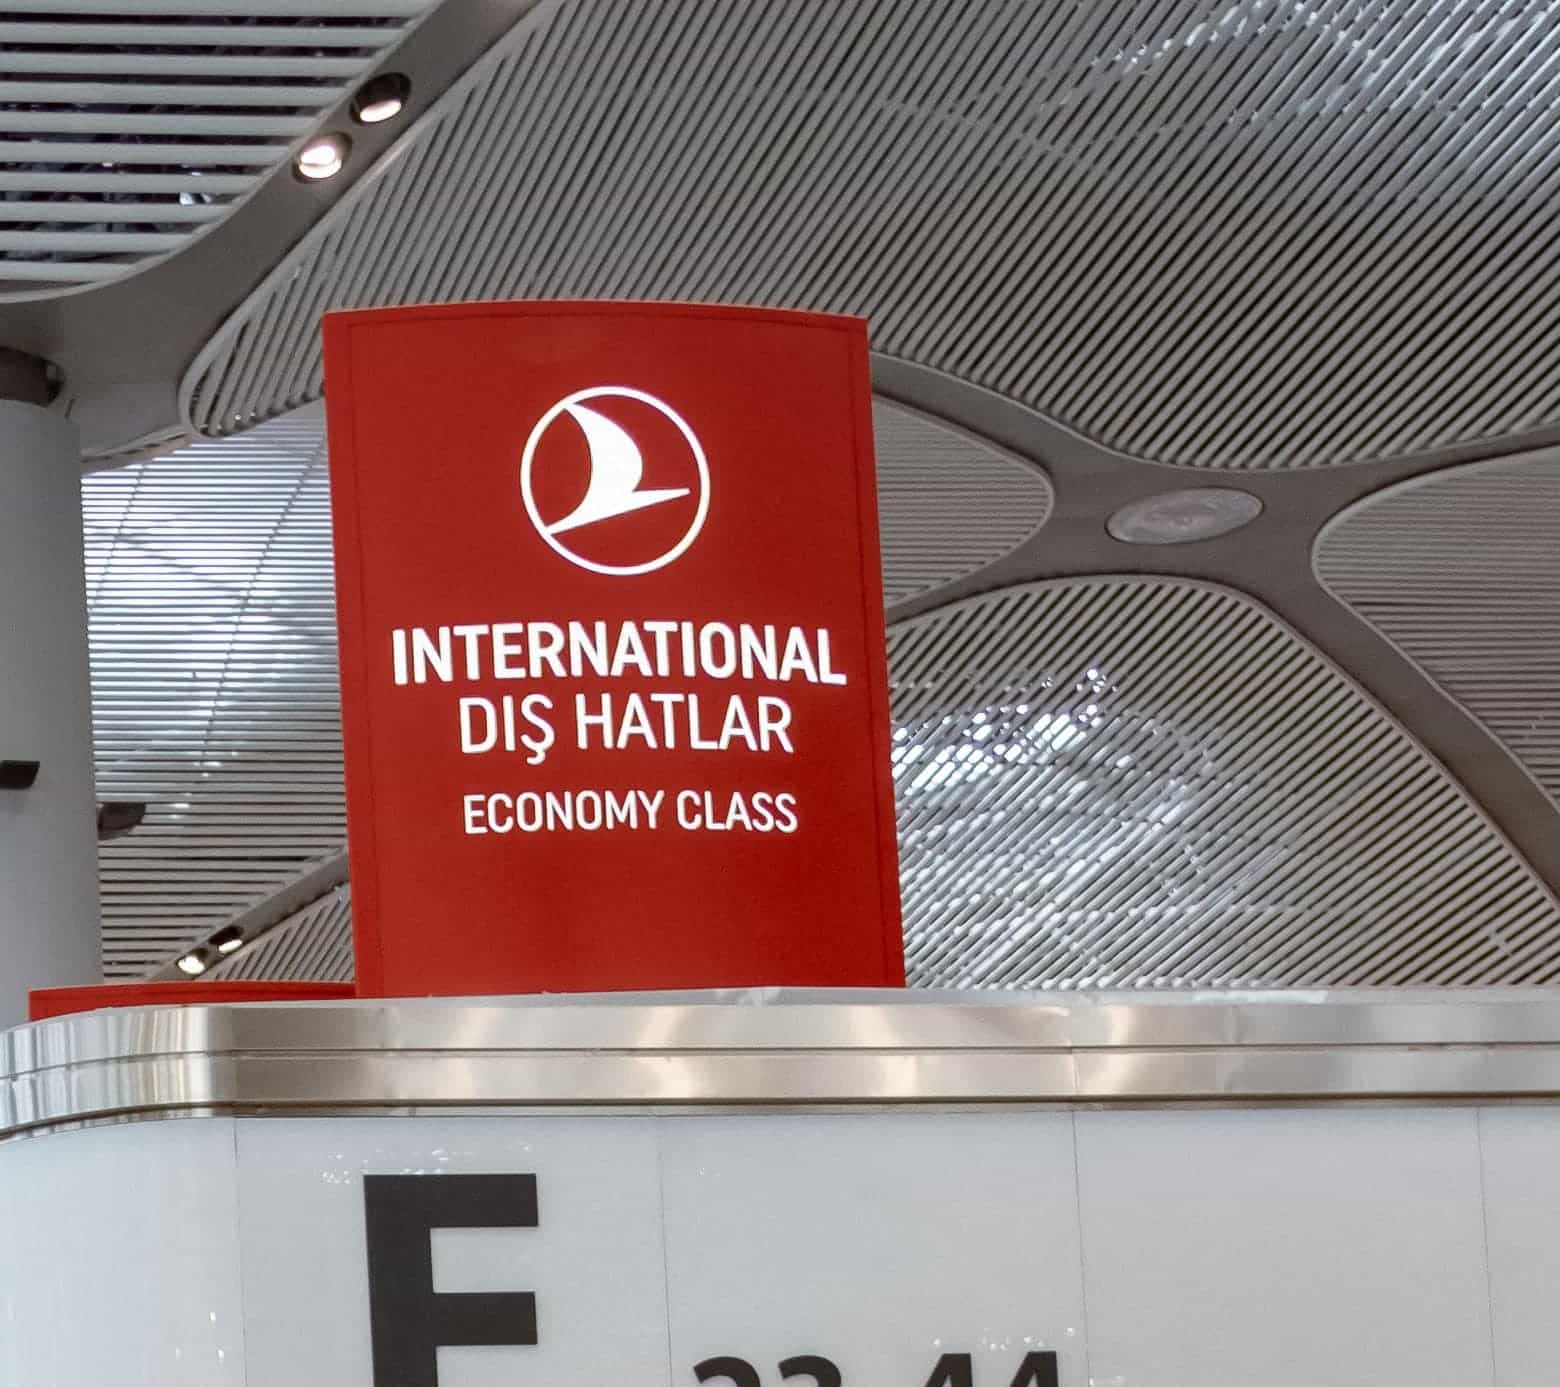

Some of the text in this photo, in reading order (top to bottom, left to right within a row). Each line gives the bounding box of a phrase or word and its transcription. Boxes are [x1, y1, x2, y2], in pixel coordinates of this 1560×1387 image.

[391, 620, 847, 686] INTERNATIONAL
[458, 692, 794, 765] DIŞ HATLAR
[463, 790, 798, 836] ECONOMY CLASS
